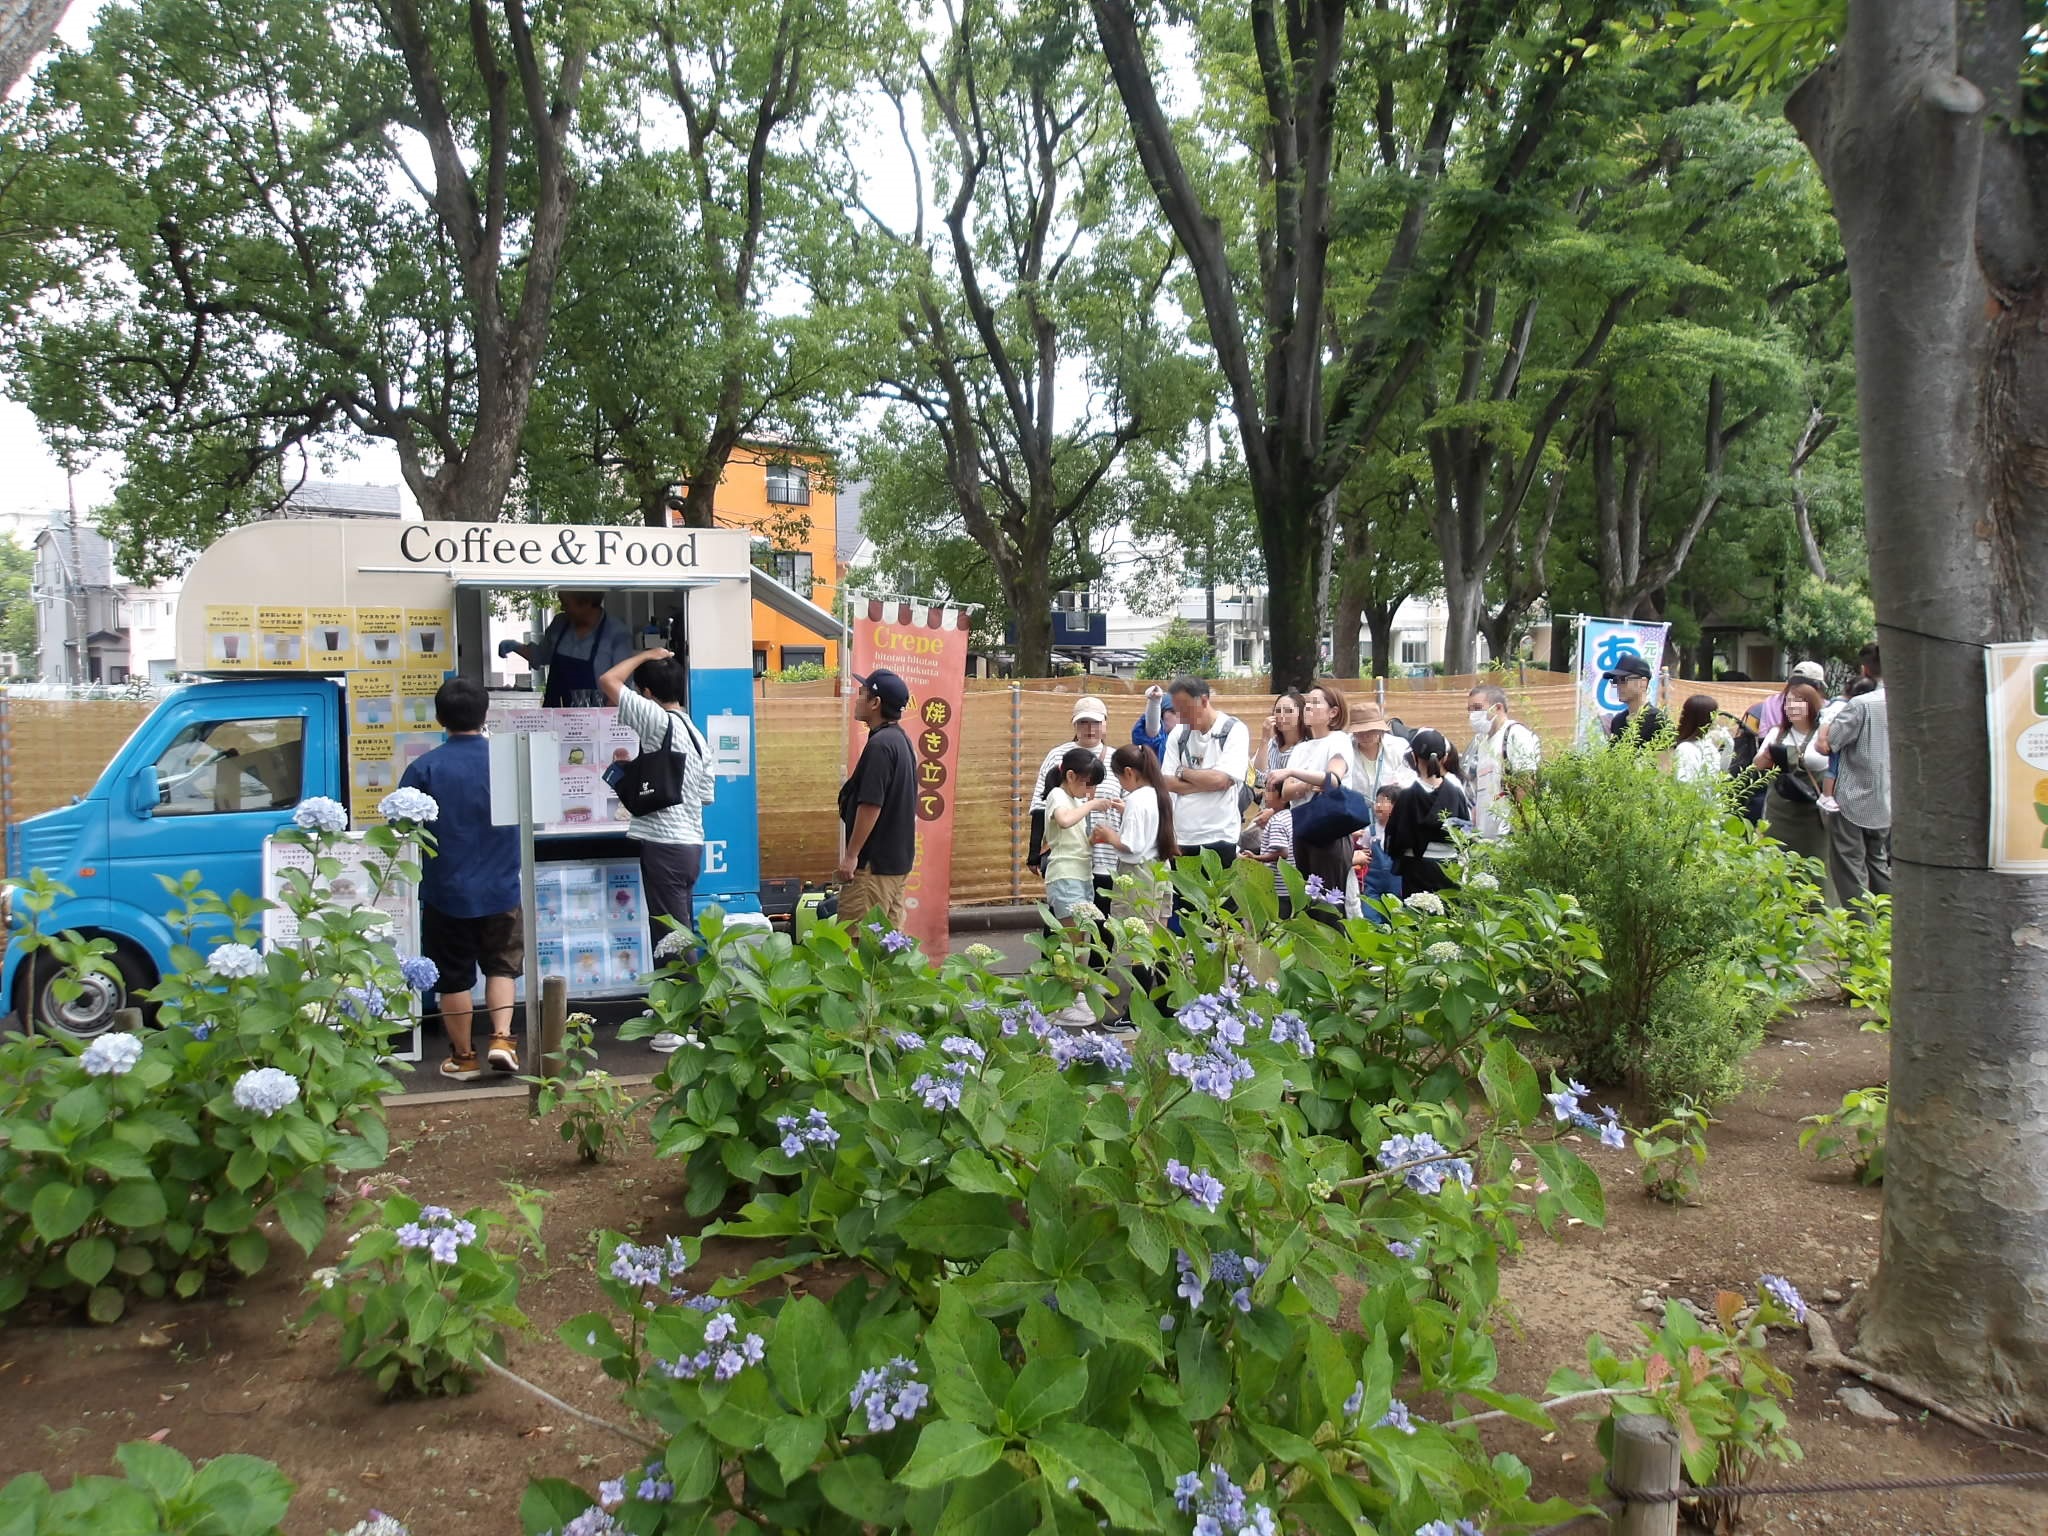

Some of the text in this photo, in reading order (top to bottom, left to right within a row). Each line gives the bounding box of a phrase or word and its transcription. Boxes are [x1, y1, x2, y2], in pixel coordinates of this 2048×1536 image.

[400, 525, 699, 567] Coffee & Food
[873, 625, 944, 655] Crepe
[920, 701, 946, 815] 焼き立て
